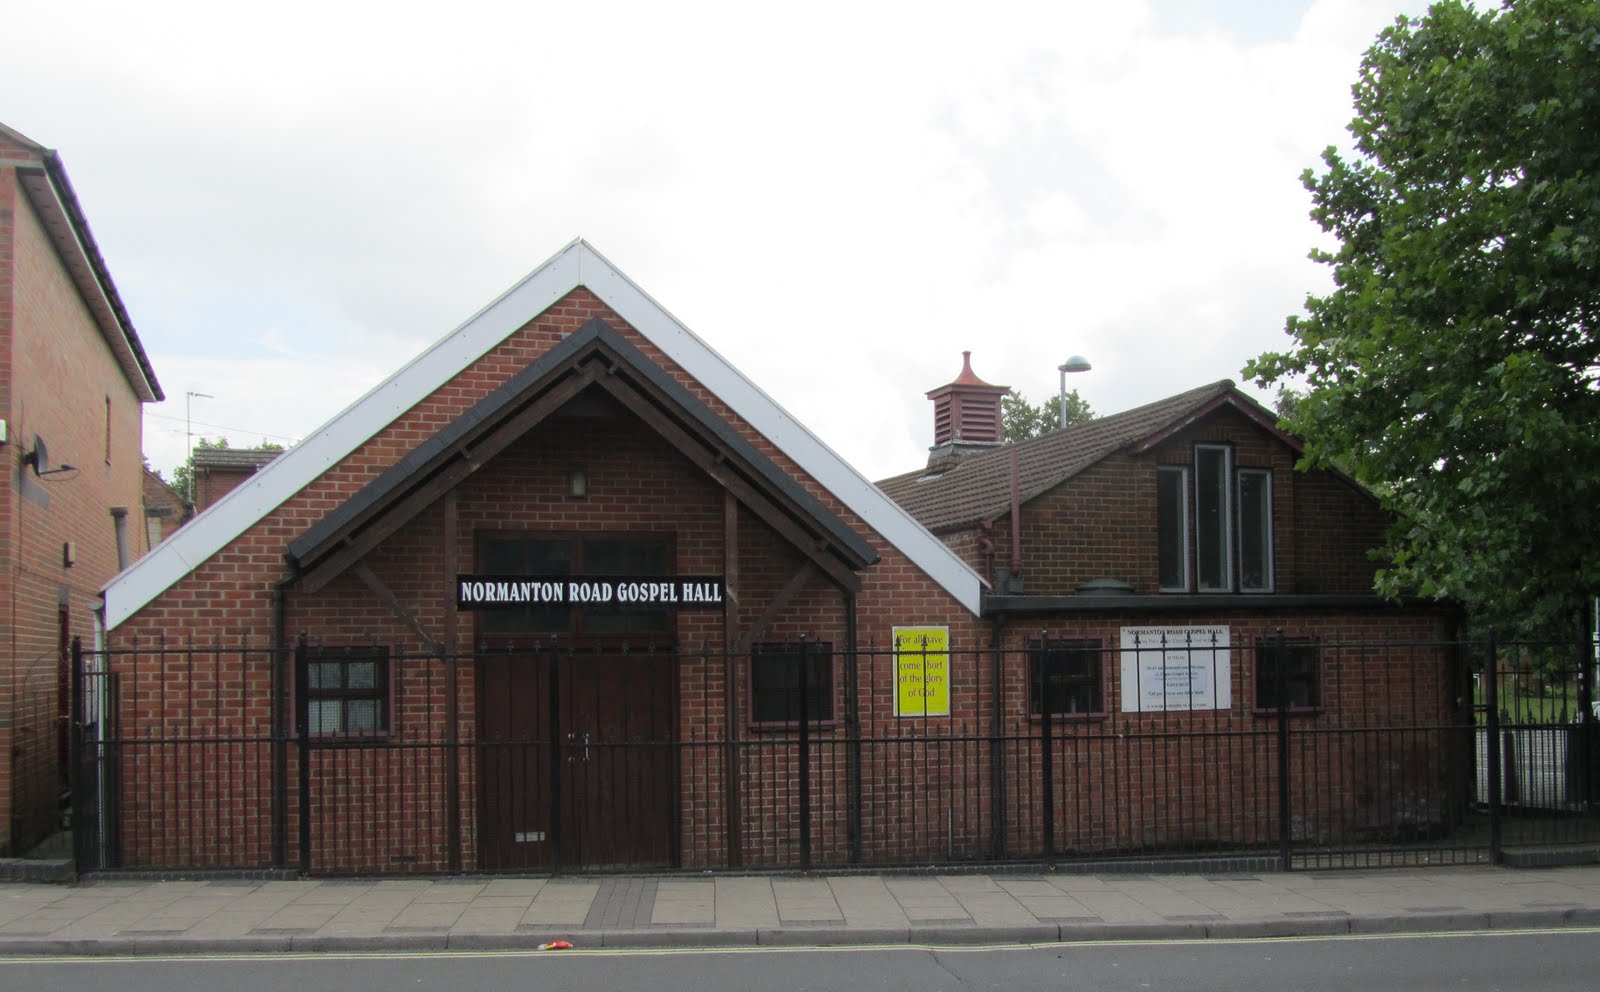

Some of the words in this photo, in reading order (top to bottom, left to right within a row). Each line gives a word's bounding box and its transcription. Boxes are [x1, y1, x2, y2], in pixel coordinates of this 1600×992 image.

[461, 582, 563, 602] NORMANTON
[569, 582, 613, 602] ROAD
[617, 582, 678, 602] GOSPEL
[682, 583, 722, 602] HALL
[899, 662, 921, 670] come
[924, 660, 943, 670] hort
[899, 673, 907, 682] of
[909, 673, 921, 682] the
[925, 673, 943, 685] glory
[908, 688, 916, 697] of
[918, 687, 935, 697] God
